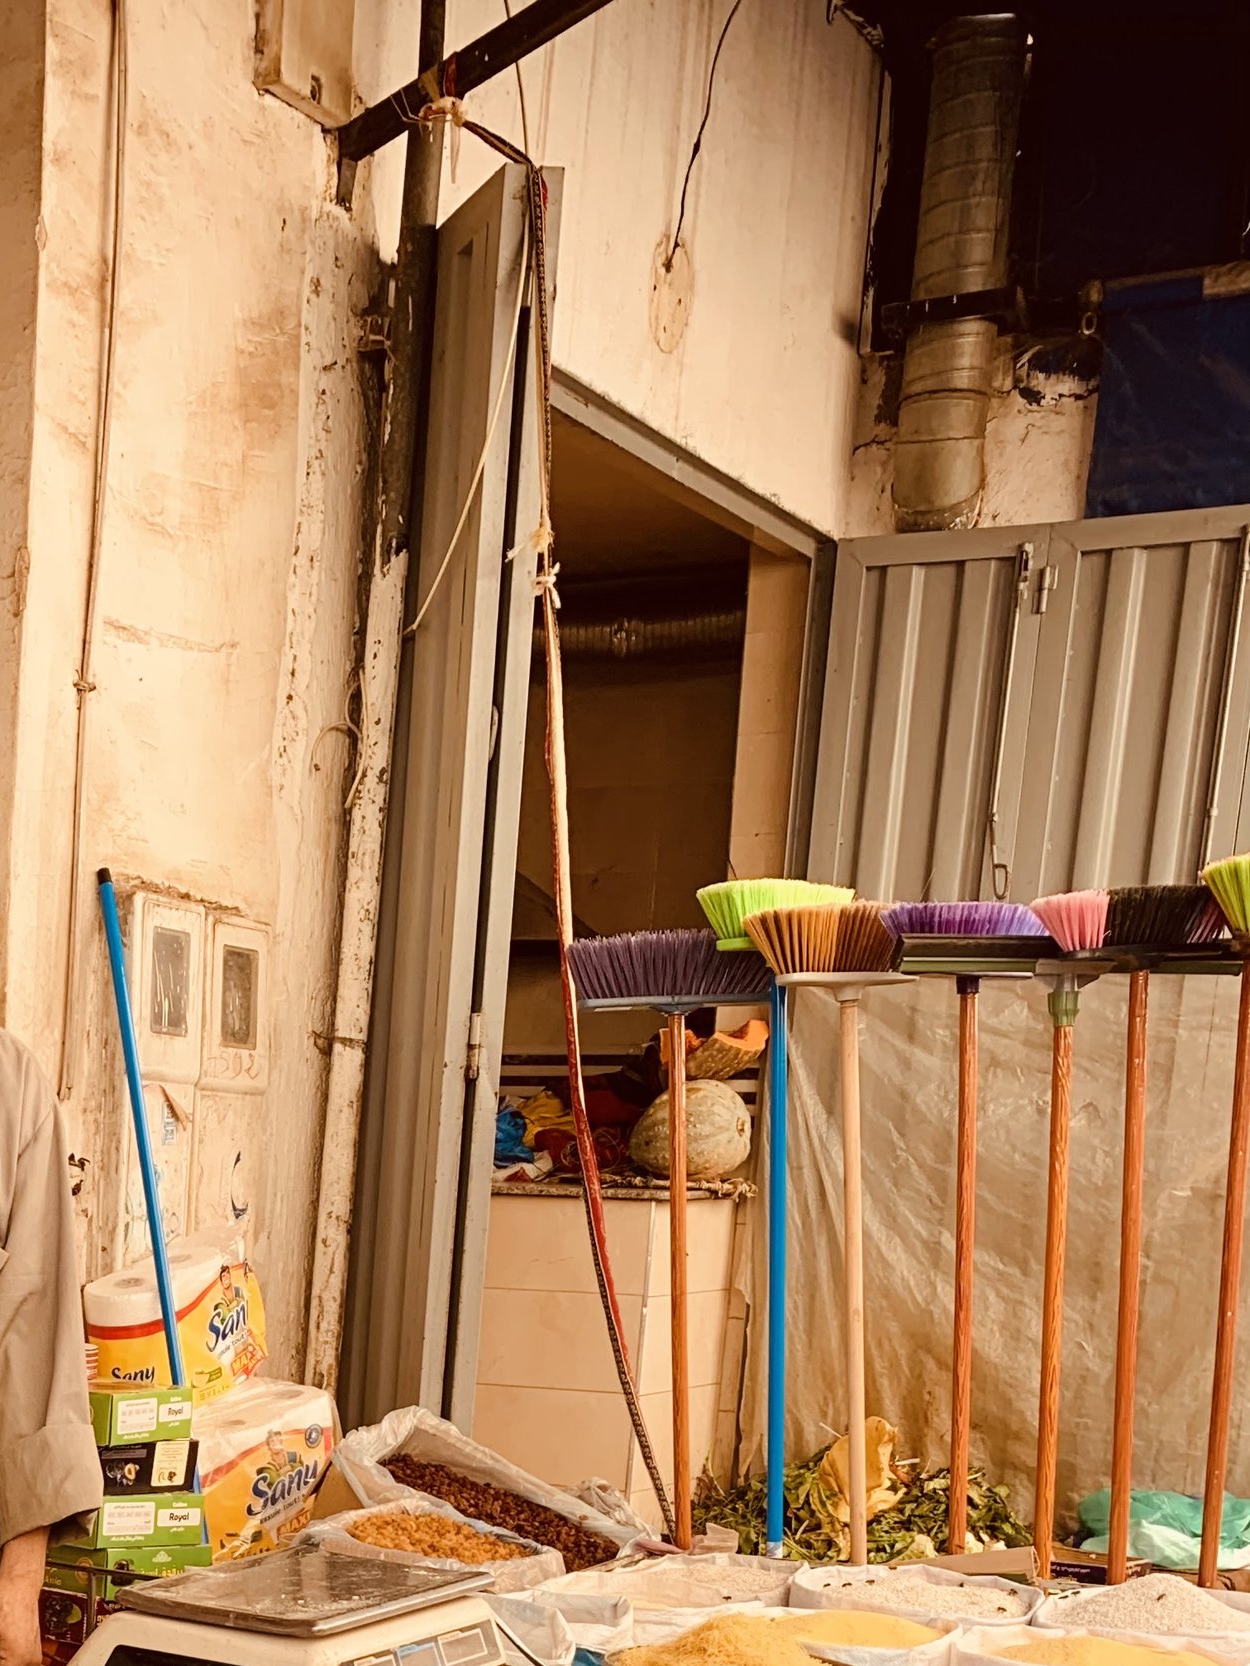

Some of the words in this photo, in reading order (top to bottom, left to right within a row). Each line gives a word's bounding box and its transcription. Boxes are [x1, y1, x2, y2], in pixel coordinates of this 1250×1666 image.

[206, 1303, 247, 1353] San
[167, 1406, 184, 1417] Royal
[169, 1512, 190, 1523] Royal
